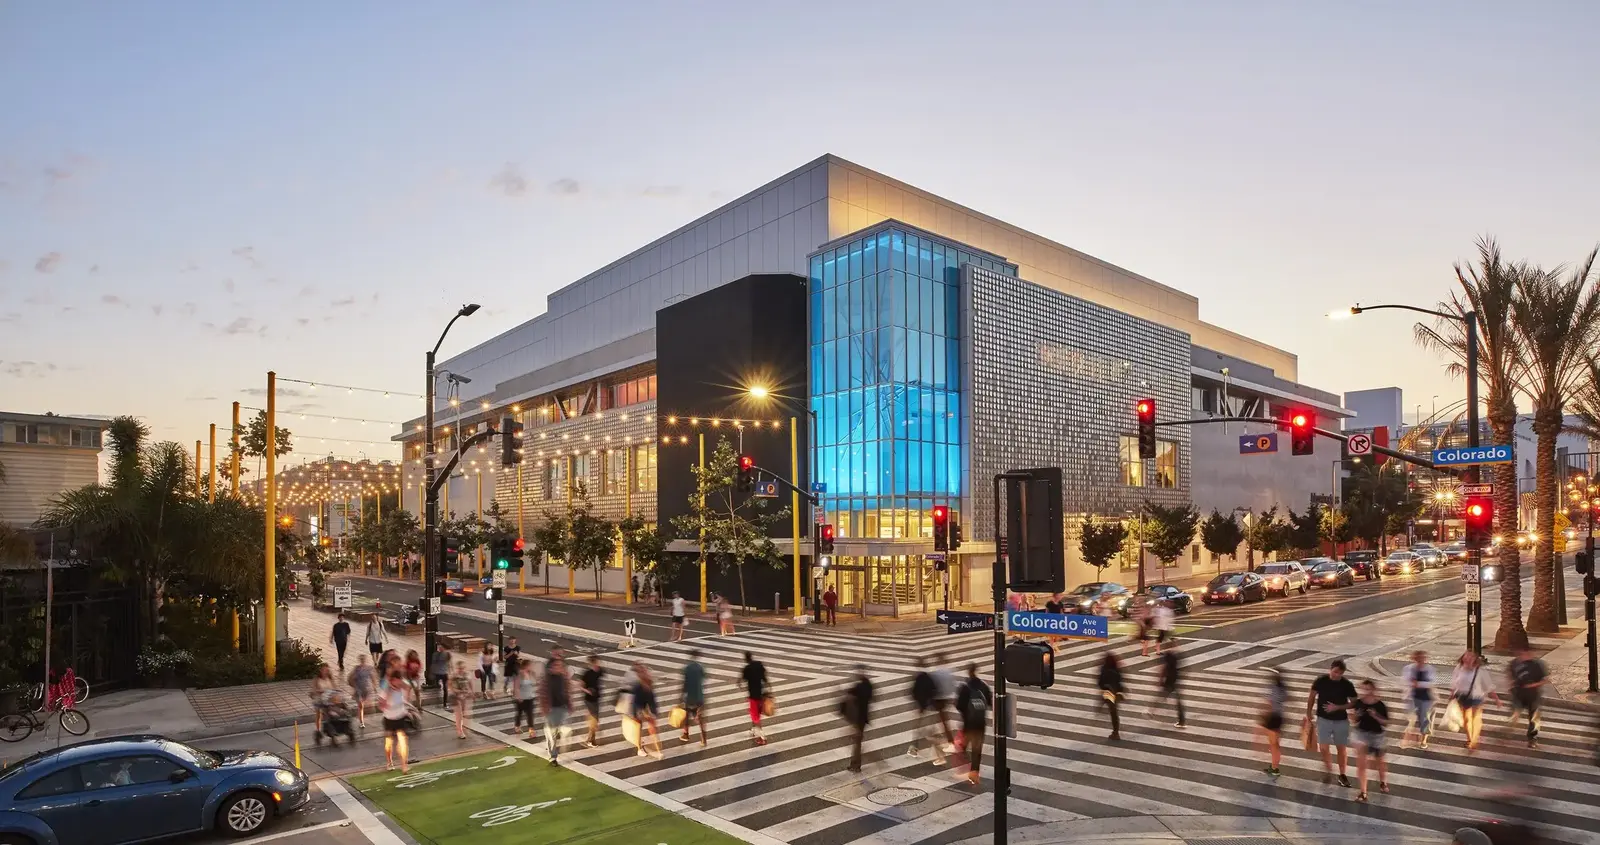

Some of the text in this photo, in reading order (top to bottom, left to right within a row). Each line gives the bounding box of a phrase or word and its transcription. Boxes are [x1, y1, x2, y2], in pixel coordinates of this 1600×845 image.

[1437, 447, 1507, 461] Colorado
[1012, 614, 1078, 631] Colorado
[1082, 618, 1097, 626] Ave
[1082, 628, 1097, 636] 400
